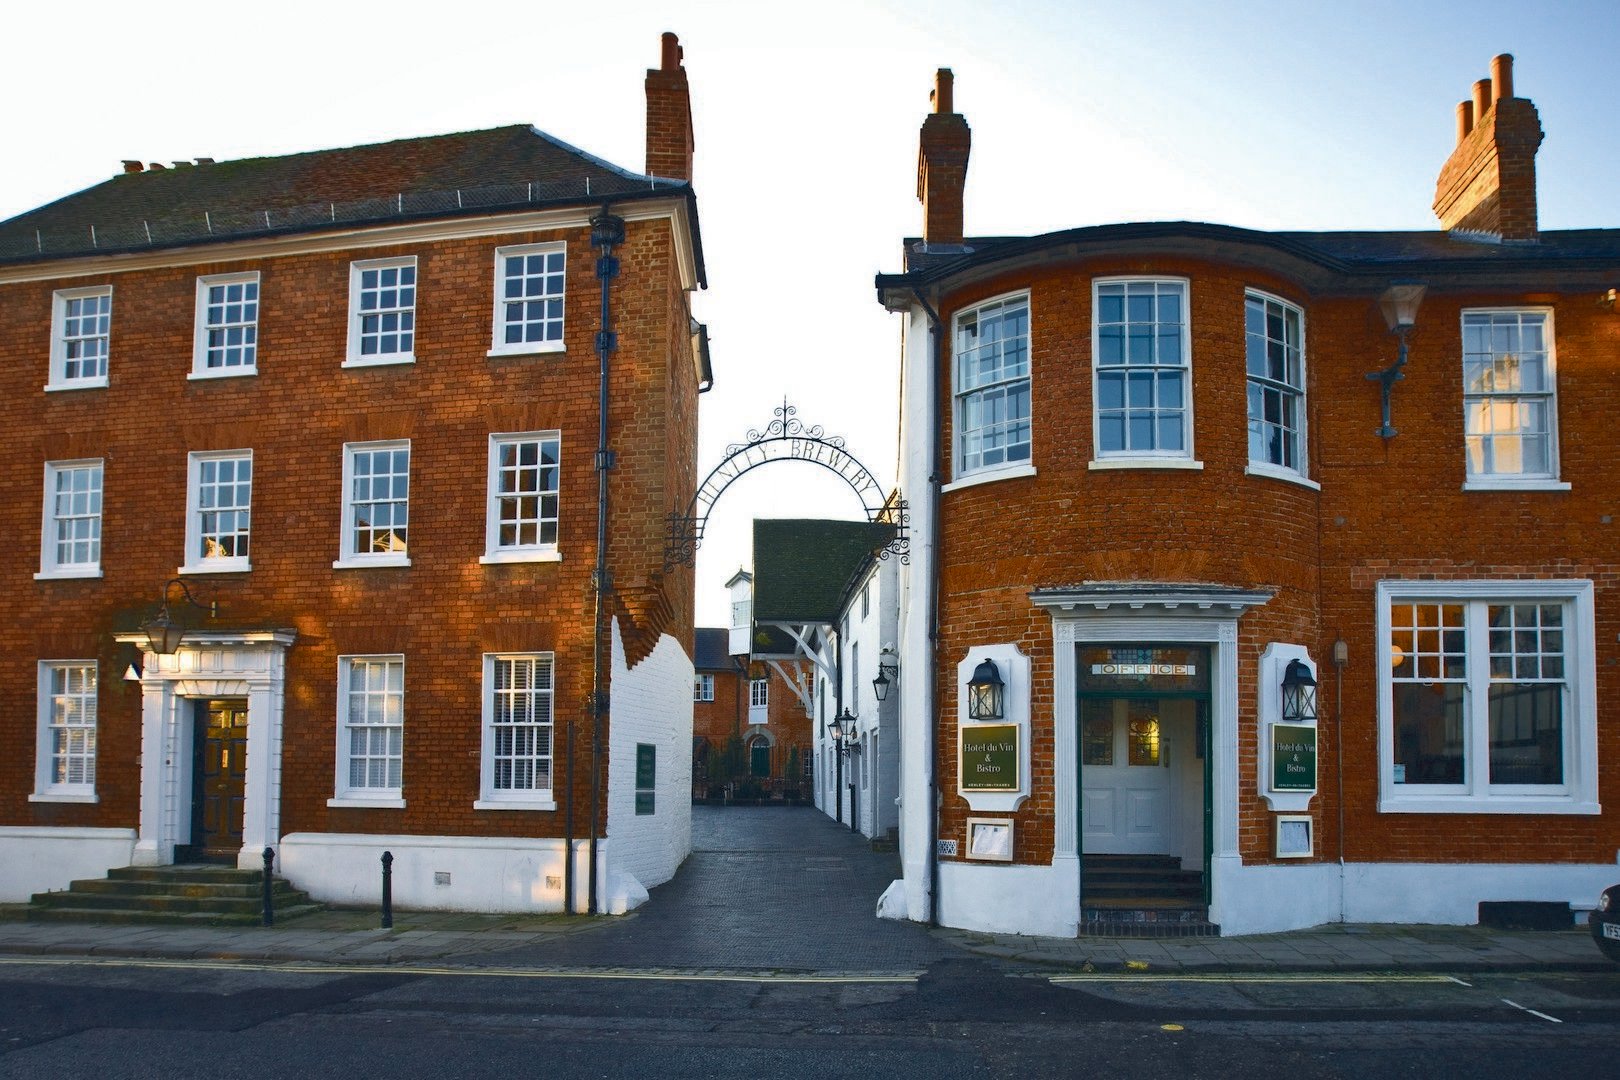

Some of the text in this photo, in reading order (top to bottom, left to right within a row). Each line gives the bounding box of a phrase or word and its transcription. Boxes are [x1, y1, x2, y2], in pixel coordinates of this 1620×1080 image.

[790, 439, 877, 493] BREWERY
[1103, 665, 1186, 674] OFFICE
[964, 742, 1014, 752] Hotel du Vin
[1276, 742, 1294, 752] Hotel
[1304, 743, 1315, 752] Vin
[984, 753, 992, 763] &
[1292, 753, 1299, 763] &
[976, 764, 1001, 773] Bistro
[1286, 763, 1306, 773] Bistro
